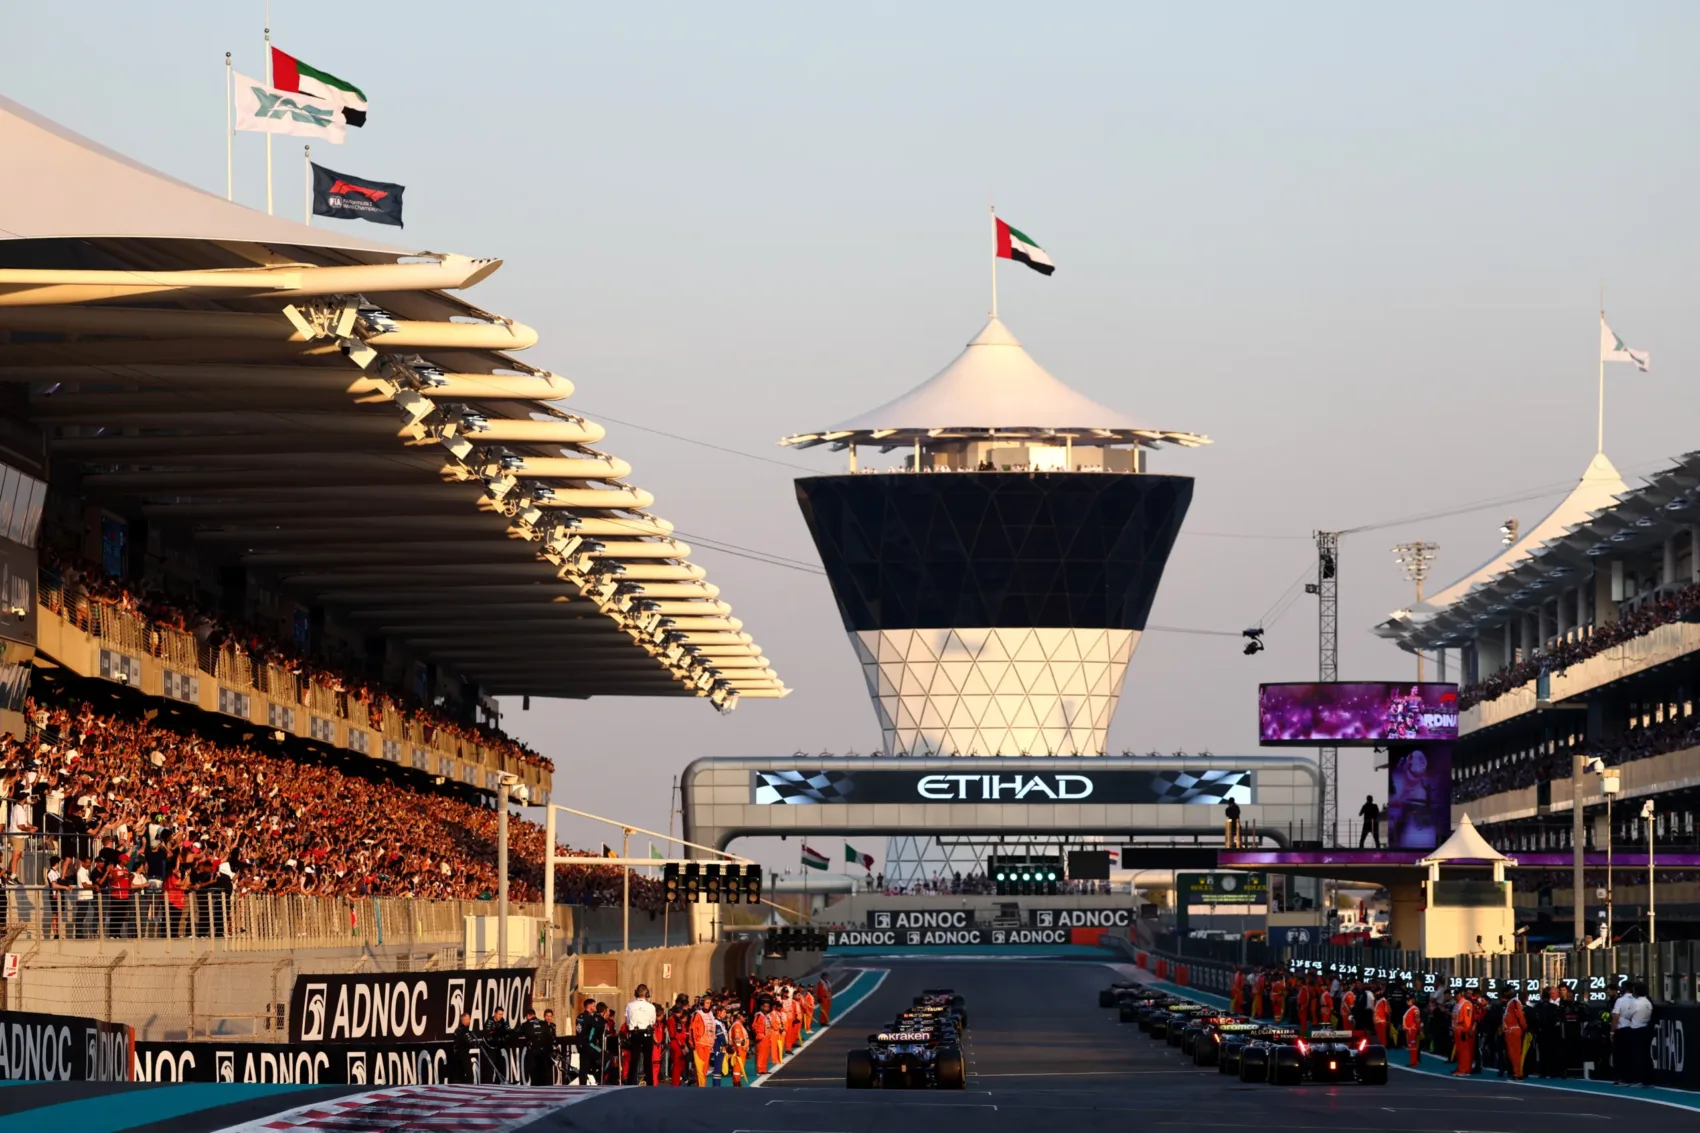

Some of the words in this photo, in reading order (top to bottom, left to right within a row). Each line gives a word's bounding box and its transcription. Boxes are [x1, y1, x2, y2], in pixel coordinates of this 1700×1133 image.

[917, 775, 1093, 799] ETIHAD
[896, 911, 966, 928] ADNOC
[1058, 910, 1129, 927] ADNOC
[839, 932, 895, 945] ADNOC
[924, 931, 980, 944] ADNOC
[1009, 930, 1066, 943] ADNOC
[1330, 963, 1337, 971] 4
[1364, 967, 1375, 976] 27
[1378, 969, 1387, 978] 11
[1400, 971, 1413, 980] 44
[1449, 977, 1462, 988] 18
[1465, 977, 1479, 988] 23
[1488, 978, 1496, 989] 3
[1527, 979, 1539, 991] 20
[1590, 976, 1606, 989] 24
[1589, 992, 1606, 1000] ZHO
[331, 980, 428, 1039] ADNOC
[469, 976, 532, 1031] ADNOC
[889, 1032, 930, 1041] kraken
[0, 1021, 72, 1081] ADNOC
[243, 1050, 329, 1084] ADNOC
[374, 1048, 447, 1085] ADNOC
